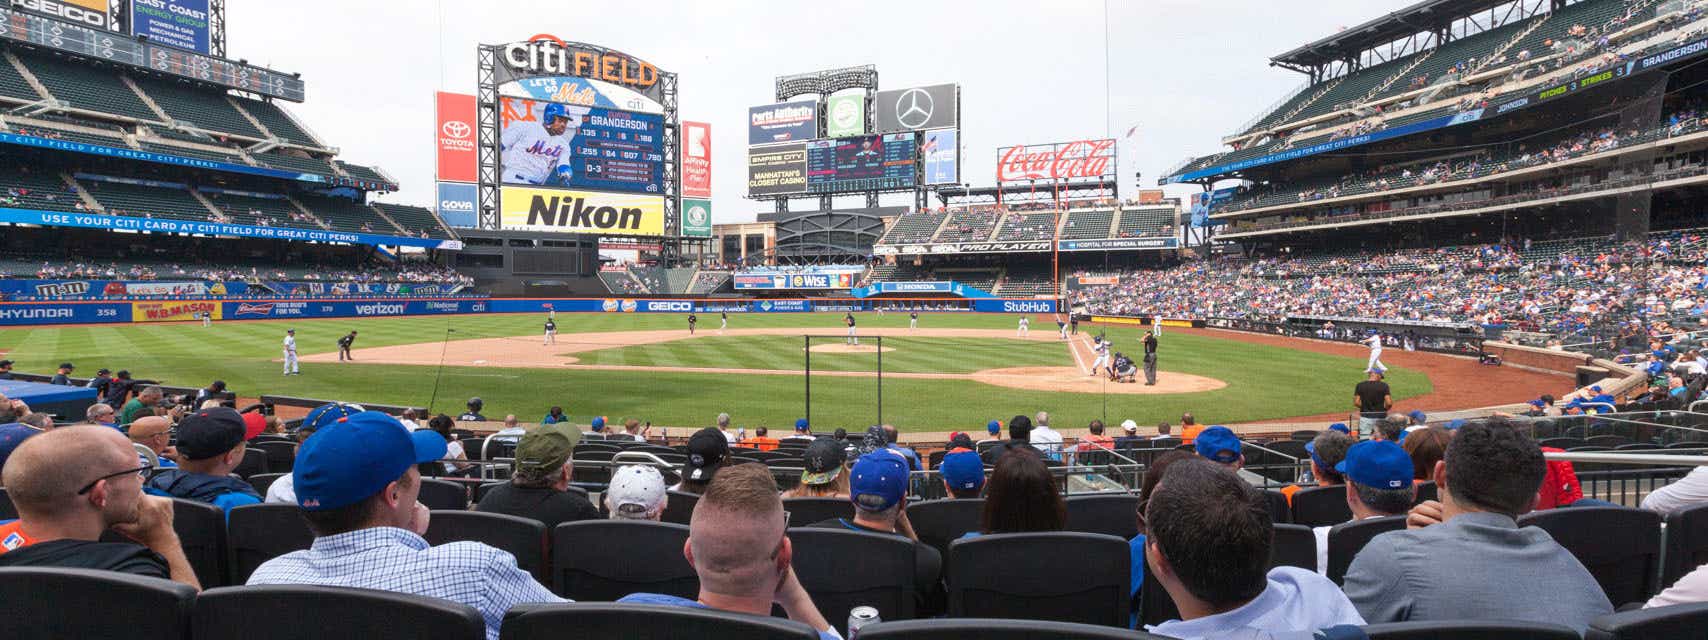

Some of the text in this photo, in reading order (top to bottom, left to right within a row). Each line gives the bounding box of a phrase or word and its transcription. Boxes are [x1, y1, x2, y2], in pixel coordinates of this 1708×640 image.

[22, 0, 104, 26] GEICO
[136, 5, 206, 28] ENERGY GROUP
[168, 4, 207, 20] COAST
[149, 34, 196, 49] PETROLEUM
[505, 40, 657, 86] citi FIELD
[530, 78, 557, 88] LET'S
[1581, 67, 1623, 87] STRIKES 3
[551, 82, 596, 105] Mets
[1539, 82, 1577, 99] PITCHES 3
[591, 116, 648, 130] GRANDERSON
[440, 138, 474, 147] TOYOTA
[442, 200, 473, 209] GOYA
[526, 195, 643, 229] Nikon
[42, 214, 359, 242] USE YOUR CITI CARD AT CITI FIELD FOR GREAT CITI PERKS!
[804, 275, 827, 287] WISE
[0, 308, 73, 318] HYUNDAI
[96, 309, 117, 317] 358
[355, 302, 404, 314] verizon
[648, 302, 691, 311] GEICO
[1004, 301, 1050, 313] StubHub
